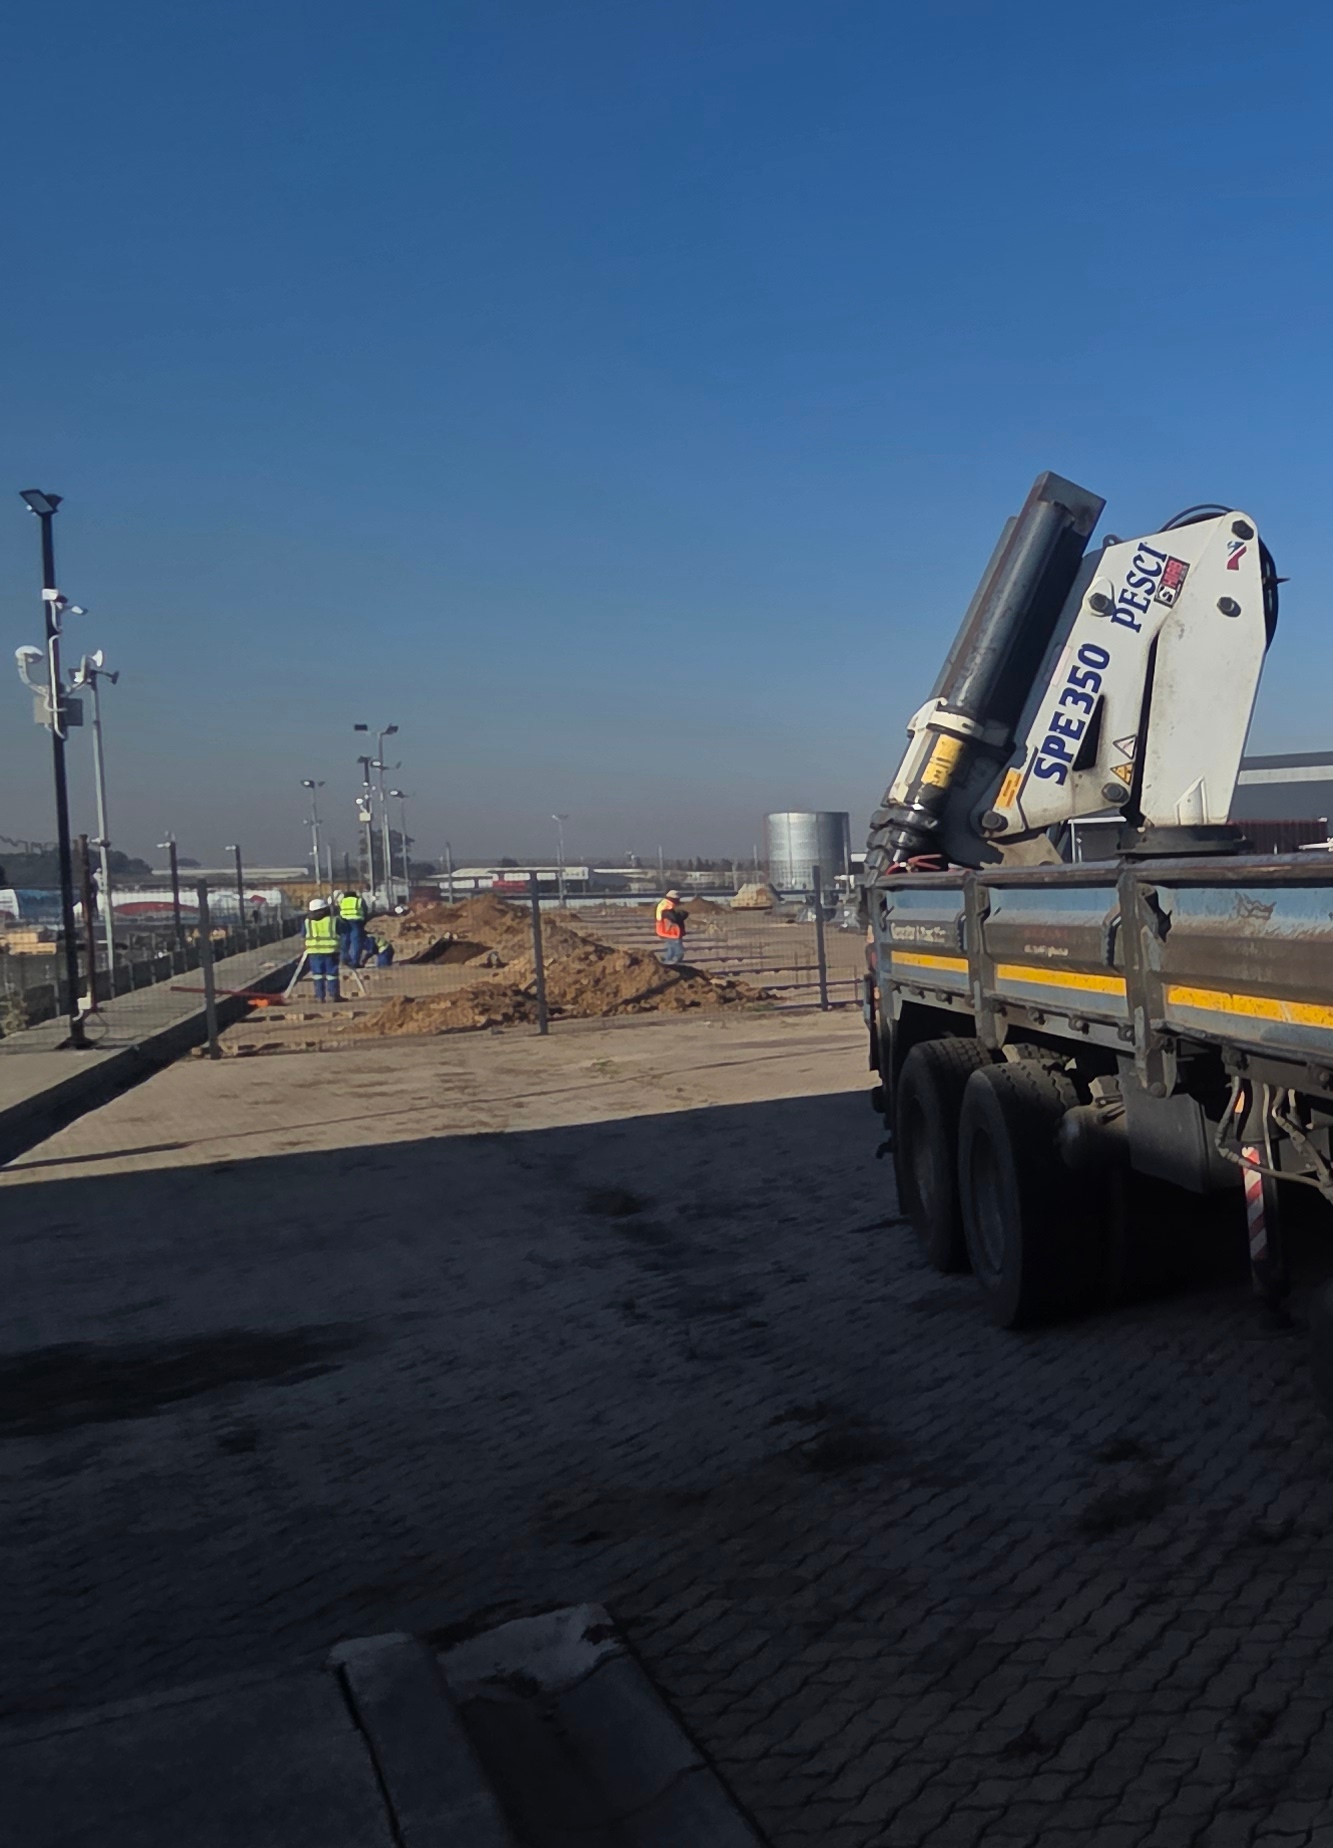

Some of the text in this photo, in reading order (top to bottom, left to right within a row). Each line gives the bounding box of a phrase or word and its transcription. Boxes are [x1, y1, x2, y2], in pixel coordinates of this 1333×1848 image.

[1110, 542, 1167, 633] PESCI
[1033, 642, 1111, 786] SPE 350
